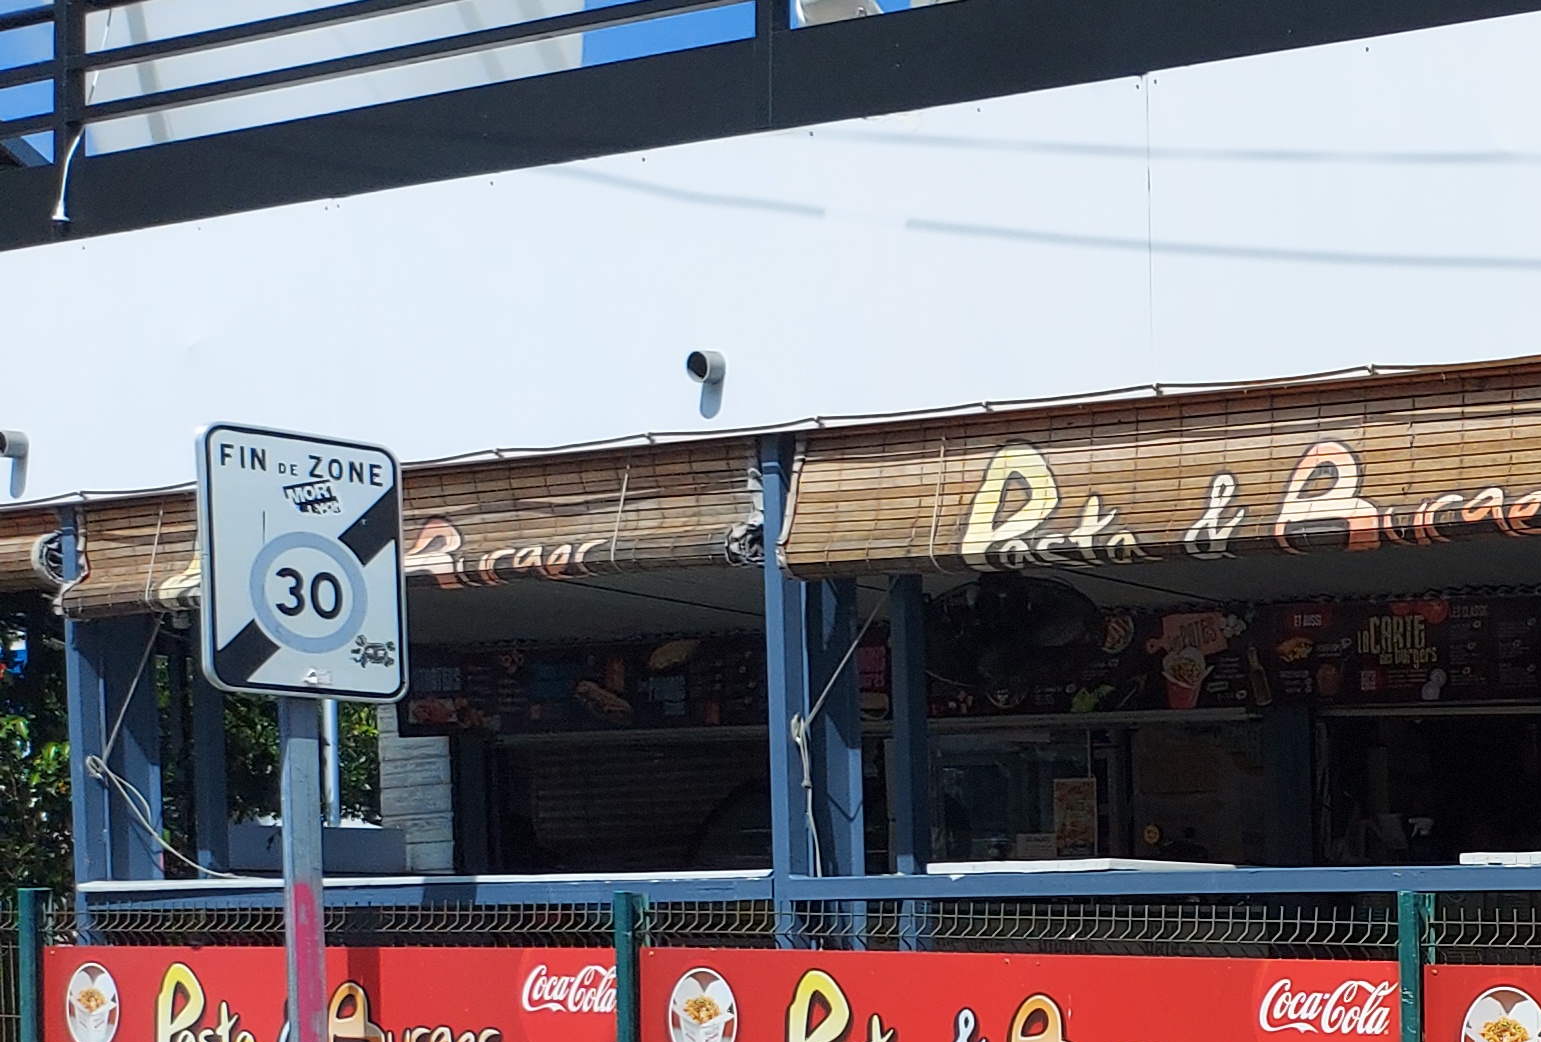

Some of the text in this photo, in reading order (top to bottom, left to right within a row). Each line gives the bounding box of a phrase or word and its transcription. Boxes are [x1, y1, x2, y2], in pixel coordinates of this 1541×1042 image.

[220, 443, 384, 487] FIN DE ZONE
[275, 567, 343, 620] 30
[522, 964, 617, 1013] Coca-Cola
[1259, 979, 1399, 1035] Coca-Cola
